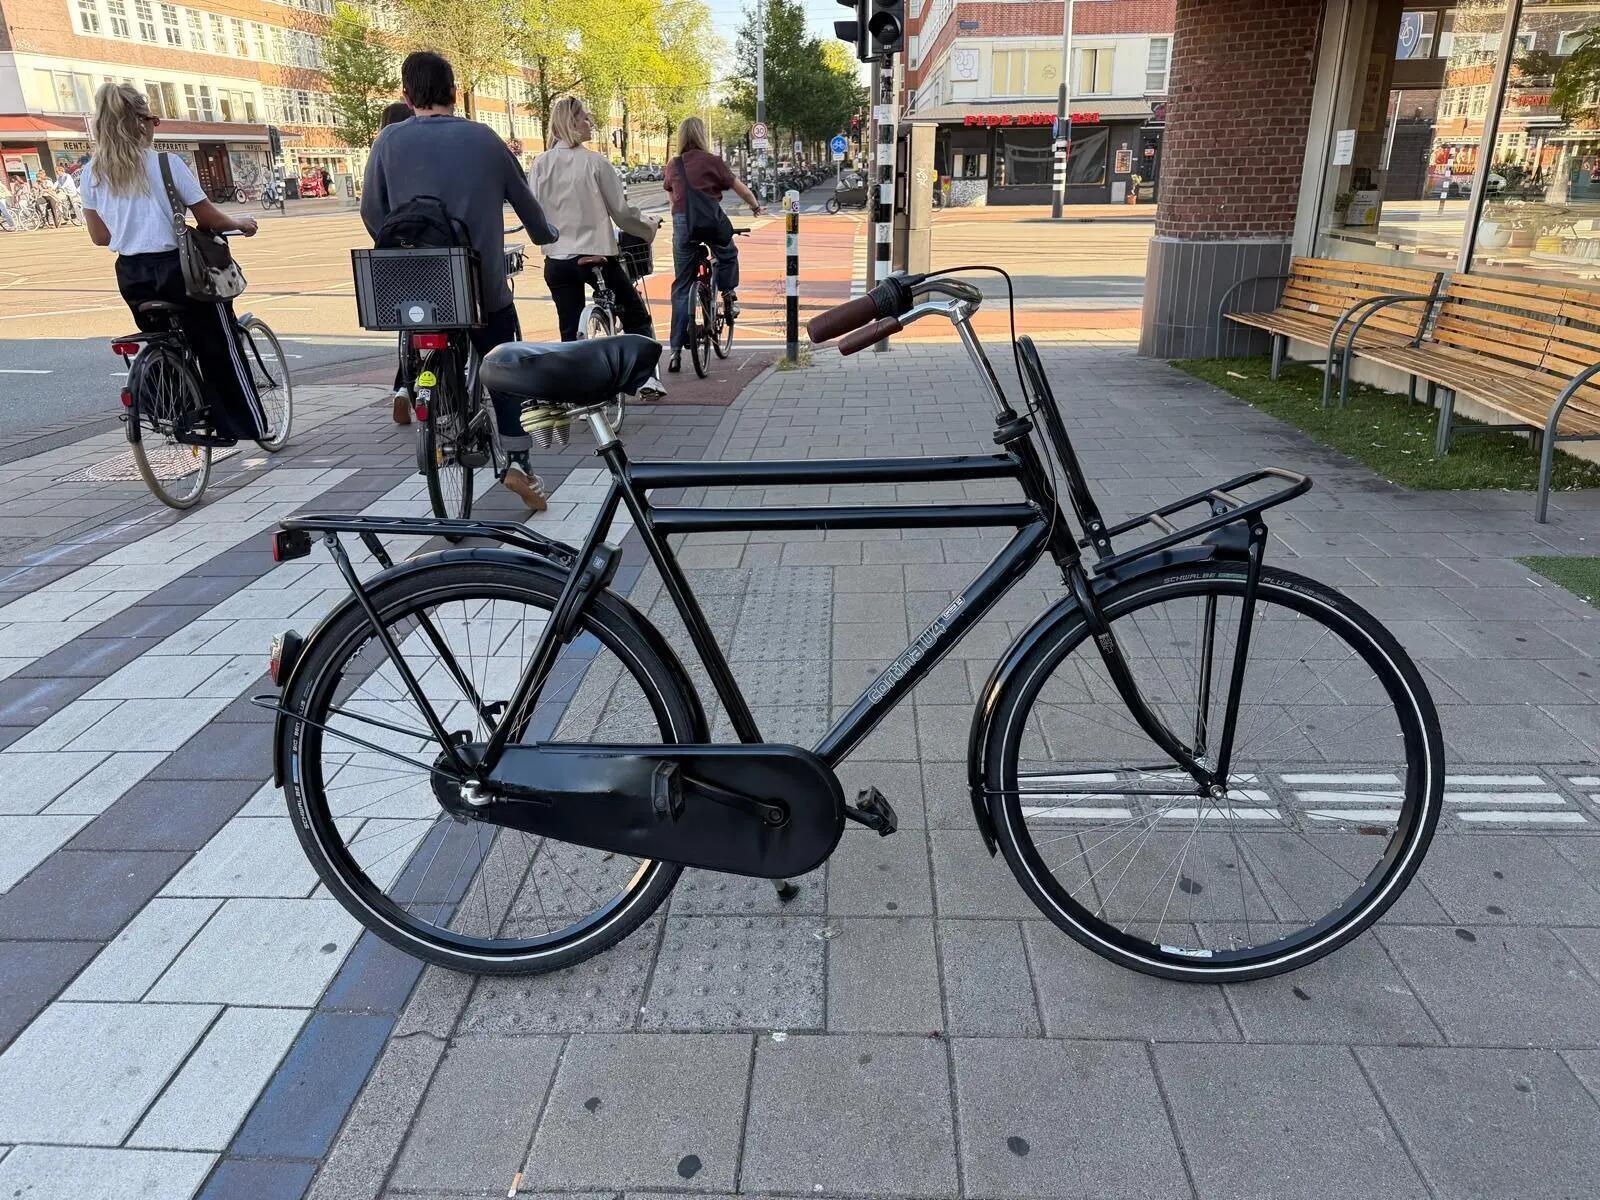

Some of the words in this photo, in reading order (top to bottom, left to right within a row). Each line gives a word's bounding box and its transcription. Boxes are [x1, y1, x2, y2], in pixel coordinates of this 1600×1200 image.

[964, 114, 1013, 126] PIDE
[1017, 112, 1100, 125] DÜNASI
[1163, 572, 1216, 584] SCHWALBE
[1262, 576, 1292, 588] PLUS
[867, 645, 925, 704] cortina
[919, 620, 947, 648] U4
[294, 785, 310, 830] SCHWALBE
